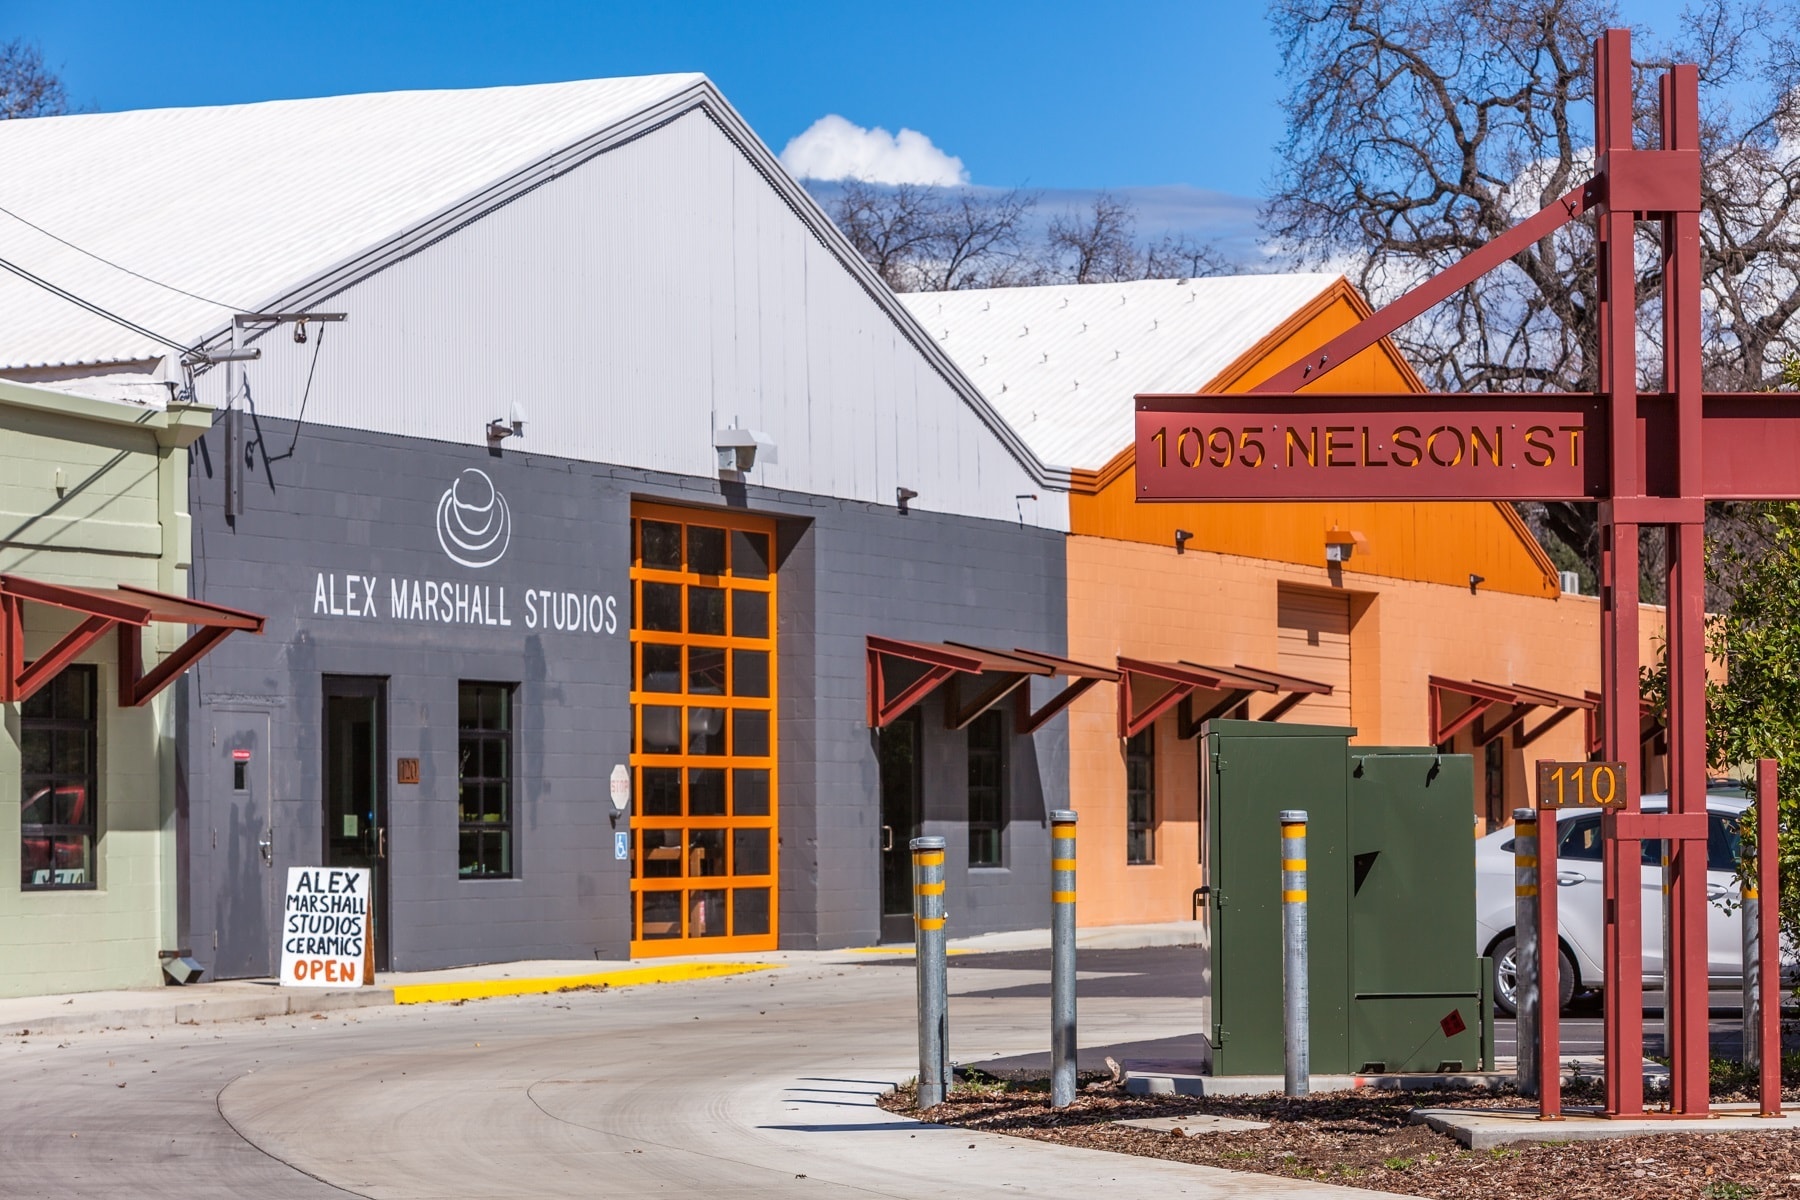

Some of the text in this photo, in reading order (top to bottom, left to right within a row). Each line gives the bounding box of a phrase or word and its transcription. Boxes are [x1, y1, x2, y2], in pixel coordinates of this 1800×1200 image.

[1151, 426, 1588, 468] 1095 NELSON ST
[313, 572, 617, 635] ALEX MARSHALL STUDIOS
[611, 779, 629, 793] STOP
[1551, 766, 1615, 804] 110
[296, 871, 360, 893] ALEX
[286, 895, 366, 915] MARSHALL
[288, 914, 362, 936] STUDIOS
[286, 936, 362, 957] CERAMICS
[294, 959, 355, 982] OPEN
